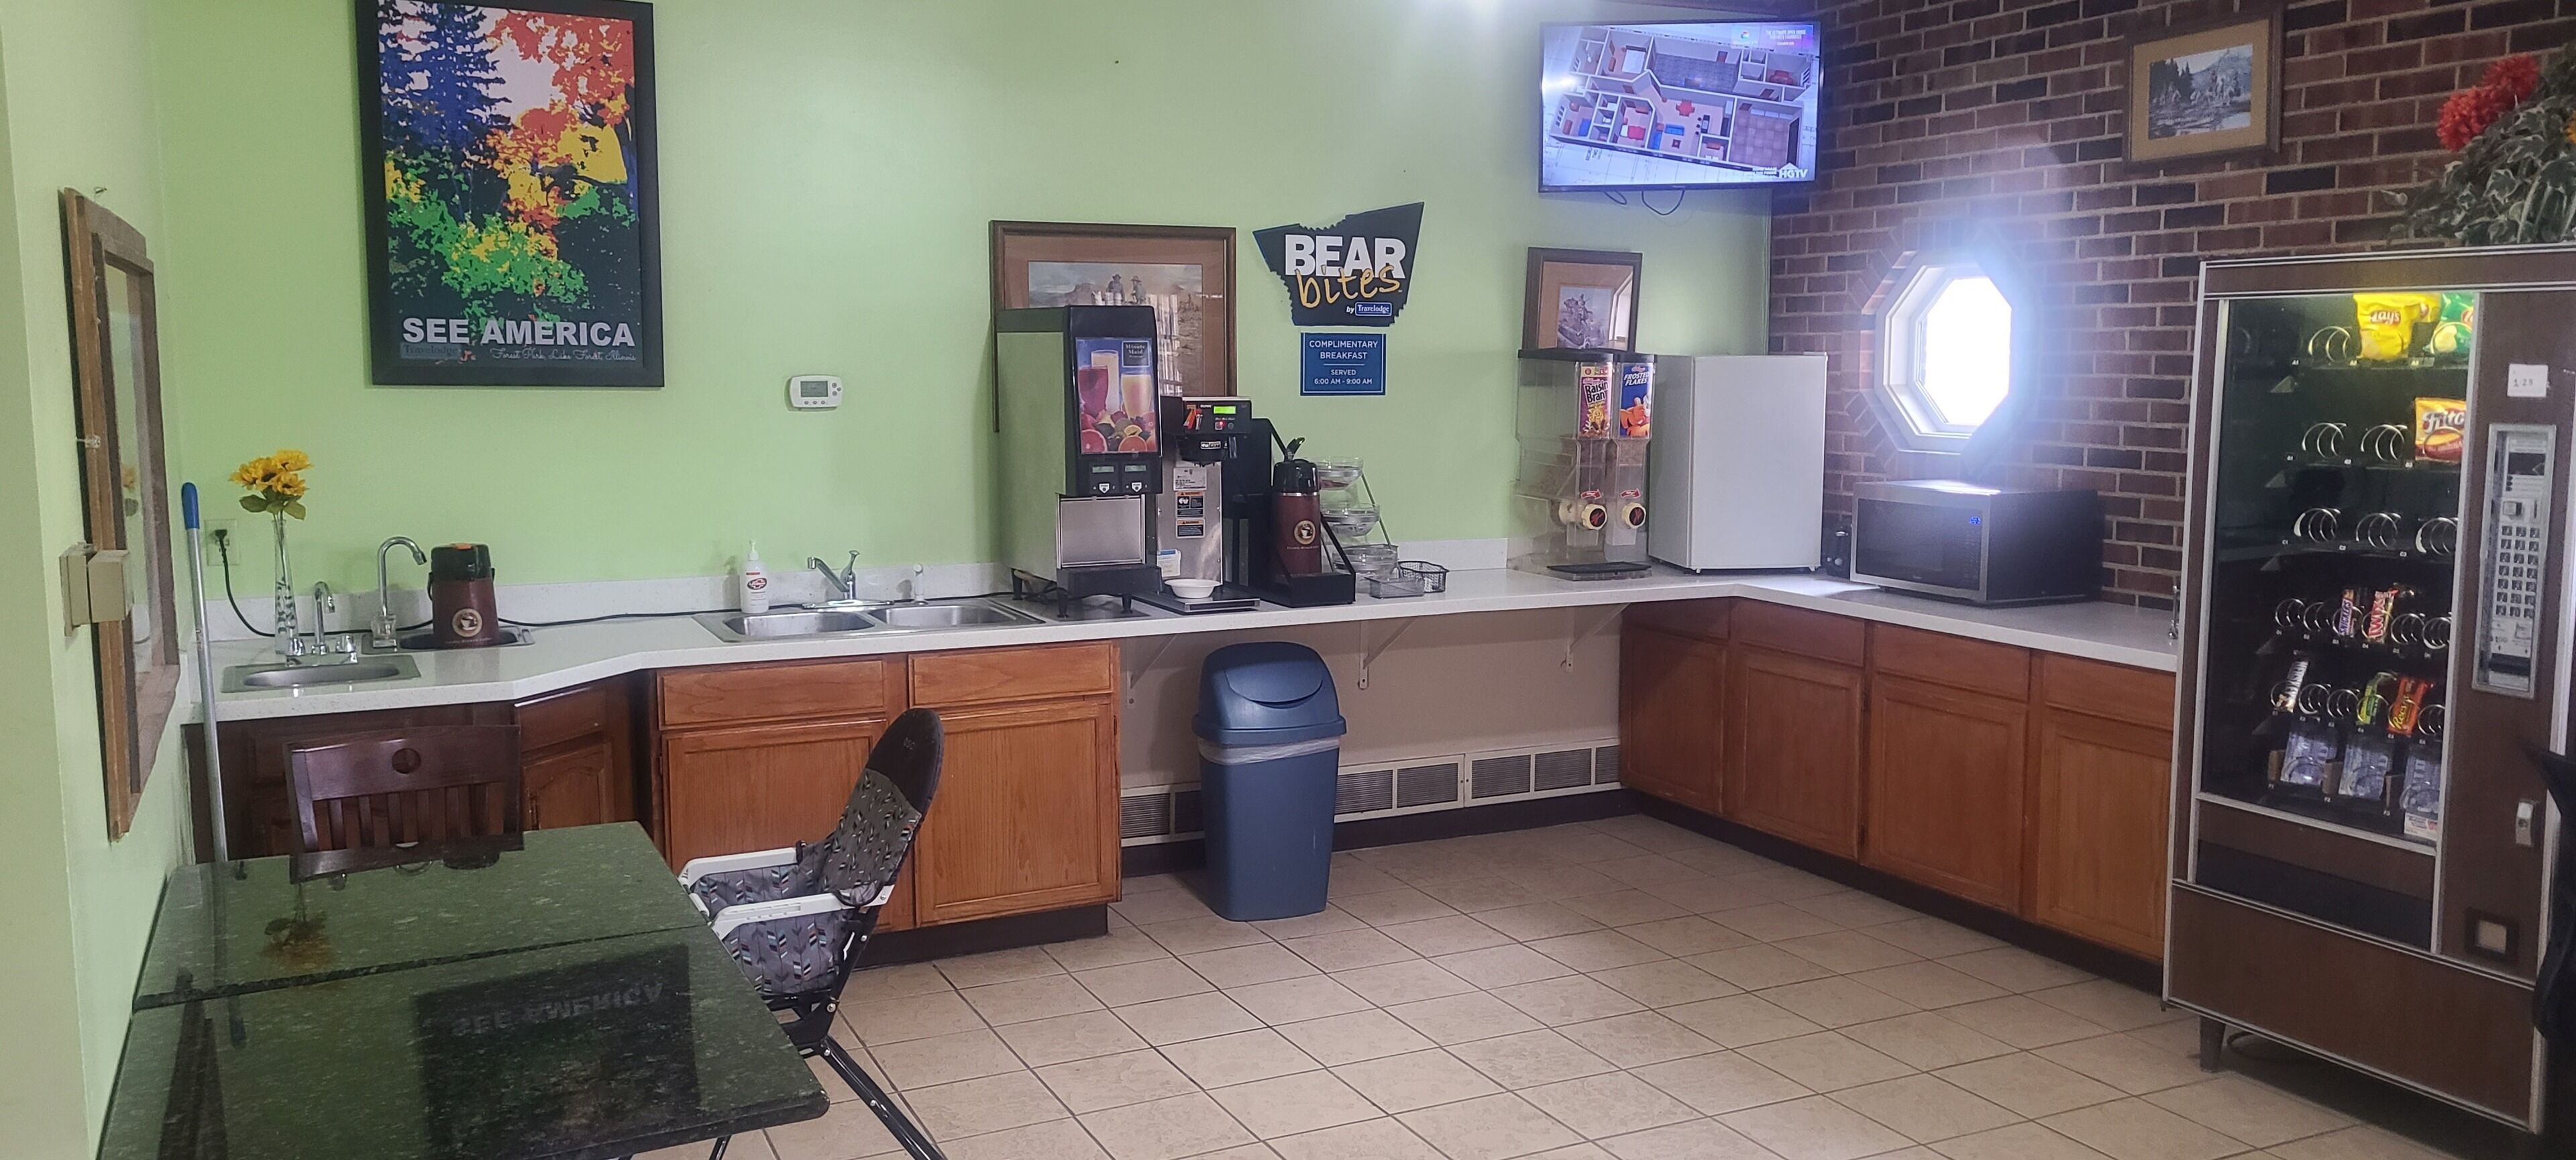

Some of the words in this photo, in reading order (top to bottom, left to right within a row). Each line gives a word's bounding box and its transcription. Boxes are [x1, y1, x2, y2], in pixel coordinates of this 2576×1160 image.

[1779, 168, 1808, 178] HGTV
[1285, 233, 1406, 279] BEAR
[1294, 264, 1401, 308] bites
[1346, 305, 1354, 314] by
[1357, 304, 1390, 313] Travelodge
[402, 317, 470, 344] SEE
[480, 319, 636, 348] AMERICA
[403, 344, 459, 356] Travelodge
[1309, 340, 1379, 348] COMPLIMENTARY
[490, 348, 521, 360] Forest
[548, 348, 571, 360] Lake
[605, 349, 637, 361] Illinois
[1320, 352, 1368, 360] BREAKFAST
[1623, 371, 1650, 381] FROSTED
[1624, 378, 1648, 386] FLAKES
[1585, 380, 1609, 394] Raisin
[1587, 391, 1605, 404] Bran
[2422, 410, 2466, 434] Frito
[2339, 600, 2352, 635] SNICKERS
[2368, 601, 2385, 639] TWIX
